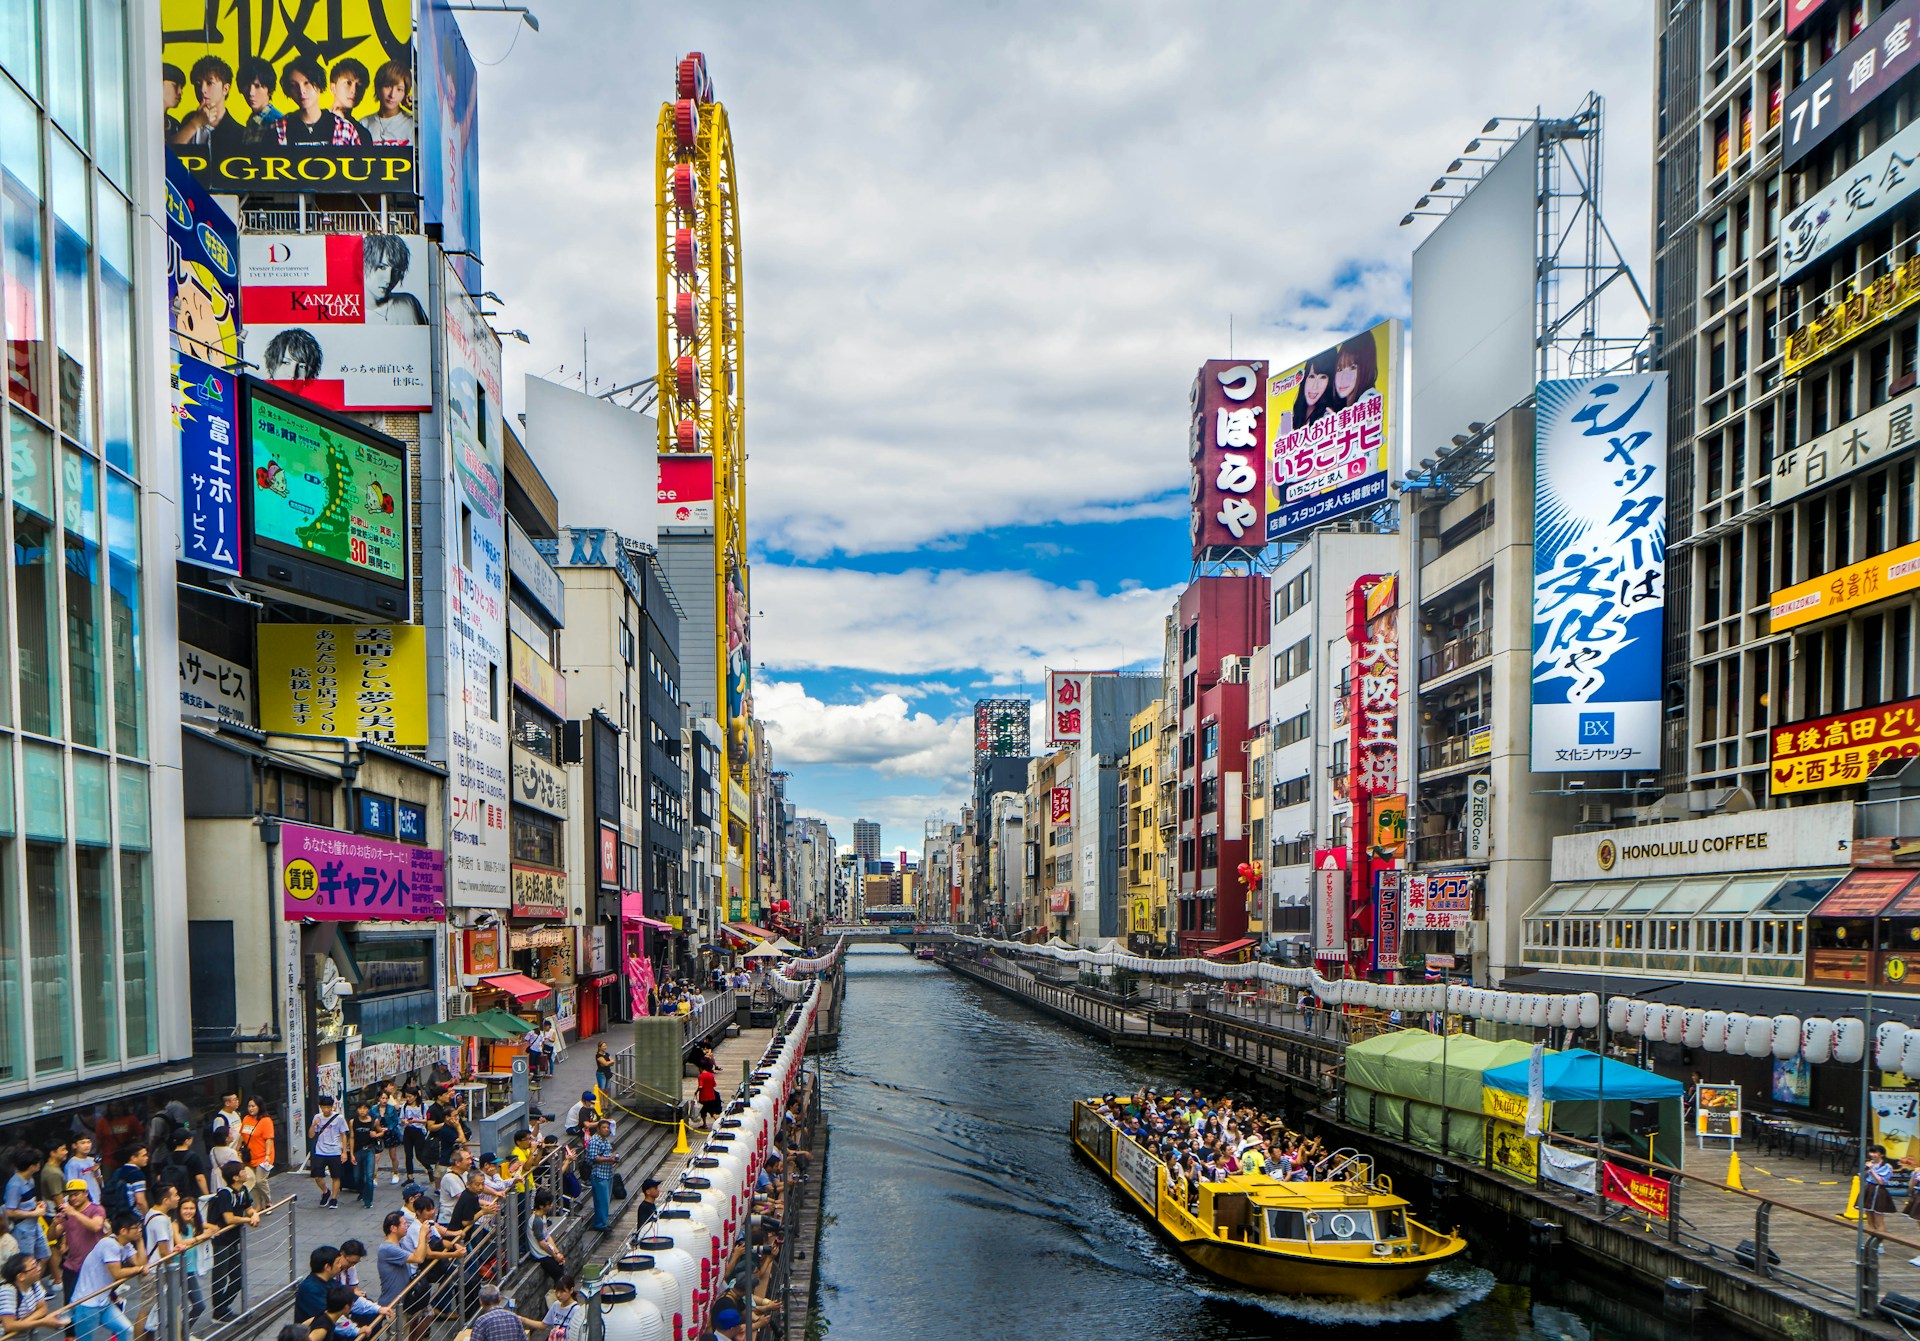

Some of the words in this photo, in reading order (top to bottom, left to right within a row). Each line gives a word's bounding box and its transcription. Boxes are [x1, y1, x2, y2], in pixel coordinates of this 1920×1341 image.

[1848, 17, 1920, 94] 個室
[1789, 78, 1833, 145] 7F
[219, 156, 412, 181] GROUP
[290, 291, 360, 311] KANZAKI
[317, 304, 360, 321] RUKA
[340, 364, 414, 375] めっちゃ面白いを
[392, 376, 425, 387] 仕事に。
[1274, 394, 1382, 458] 高収入お仕事情報
[1274, 415, 1381, 484] いちごナビ
[1804, 402, 1916, 487] 白木屋
[1776, 453, 1798, 479] 4F
[207, 414, 233, 565] 富士ホーム
[1289, 476, 1325, 498] いちごナビ
[1327, 470, 1343, 485] 求人
[190, 472, 207, 551] サービス
[350, 537, 367, 565] 30
[1771, 594, 1816, 617] TORIKIZOKU
[315, 628, 339, 735] あなたのお店づくり
[353, 628, 397, 744] 素晴らしい夢の実現
[290, 667, 312, 727] 応援します
[1357, 633, 1399, 793] 大阪王将
[1584, 720, 1610, 736] BX
[1796, 752, 1863, 785] 酒場
[369, 801, 380, 828] 酒
[453, 796, 478, 822] コスパ
[487, 804, 507, 830] 最高!
[1060, 789, 1069, 812] ツルハ
[1472, 797, 1484, 828] ZERO
[399, 809, 417, 835] たばこ
[303, 836, 408, 864] あなたも憧れのお店のオーナーに!
[1622, 838, 1698, 860] HONOLULU
[1702, 831, 1768, 853] COFFEE
[289, 868, 315, 891] 賃貸
[319, 860, 411, 906] ギャラント
[1409, 878, 1425, 909] 薬
[1429, 880, 1469, 899] ダイコク
[316, 894, 323, 905] の
[1381, 890, 1395, 931] ダイコク
[1424, 912, 1450, 928] 免税
[1378, 954, 1398, 963] 免税
